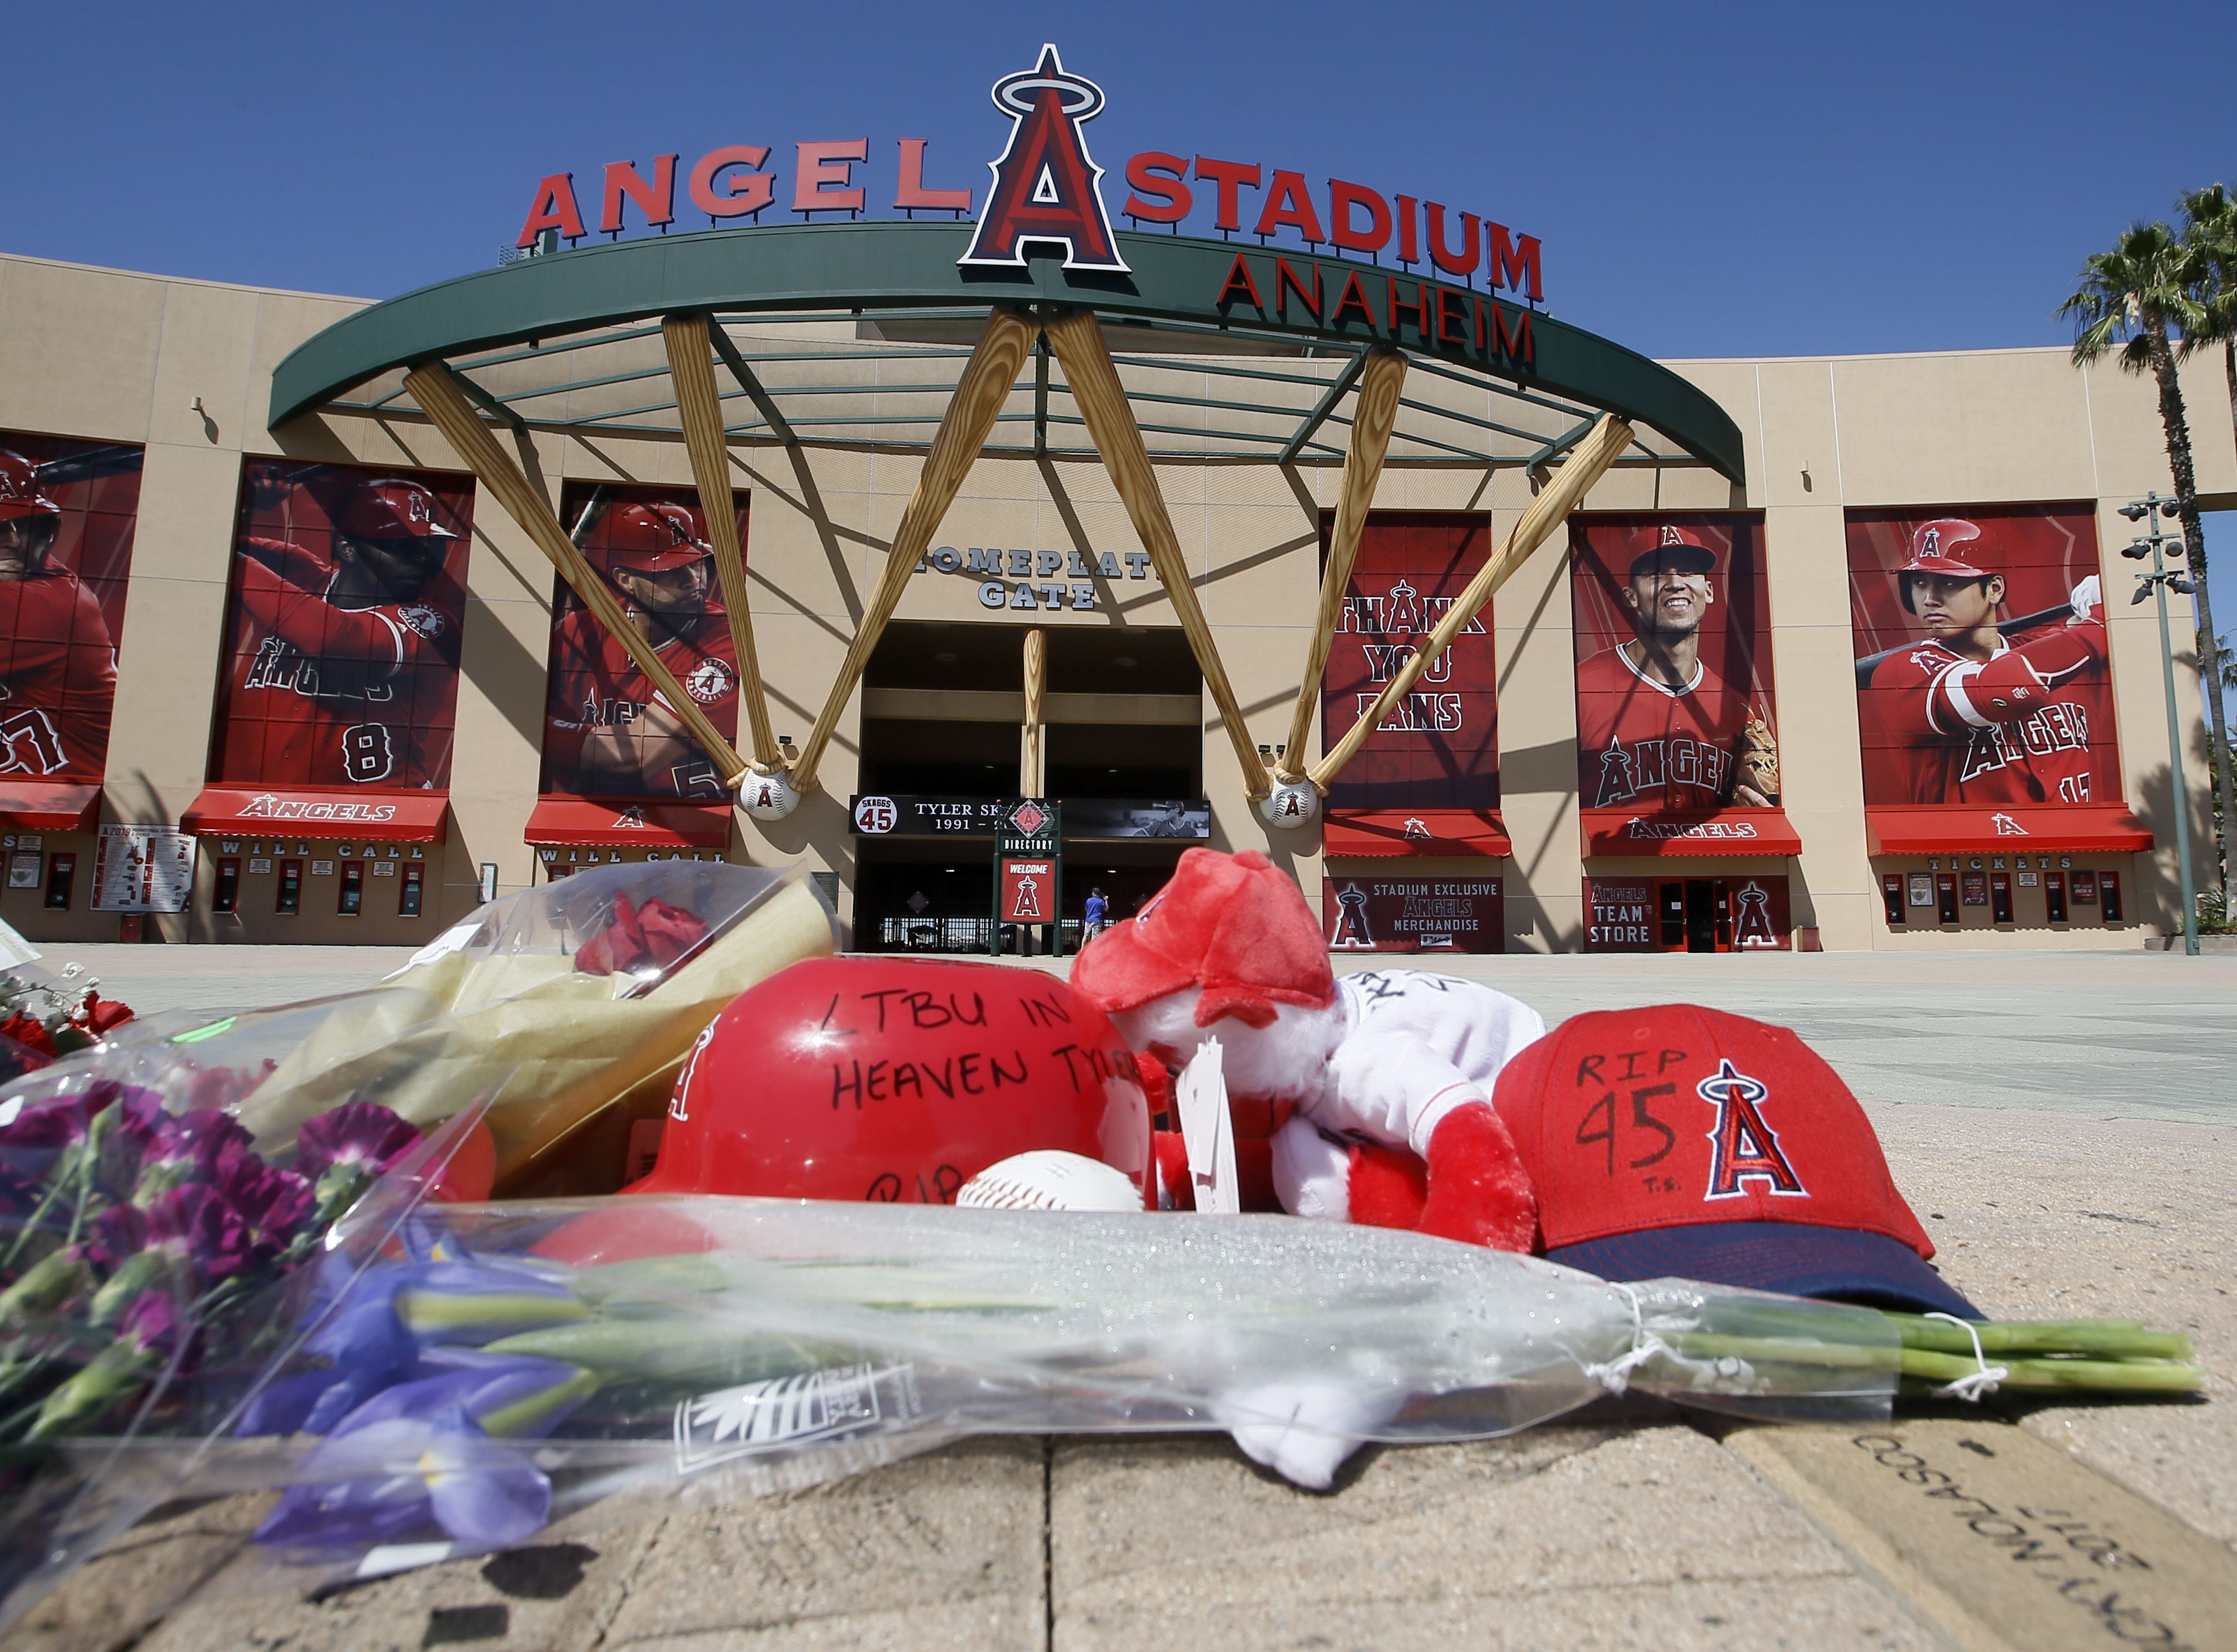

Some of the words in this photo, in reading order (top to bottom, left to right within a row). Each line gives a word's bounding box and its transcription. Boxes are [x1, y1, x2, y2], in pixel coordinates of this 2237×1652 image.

[516, 136, 973, 250] ANGEL
[1122, 151, 1544, 302] STADIUM
[1217, 251, 1533, 363] ANAHEIM
[913, 546, 1162, 580] OMEPLAT
[978, 581, 1095, 610] GATE
[341, 722, 393, 782] 8
[235, 794, 396, 821] ANGELS
[862, 798, 891, 808] SKAGGS
[915, 804, 973, 816] TYLER
[859, 808, 892, 830] 45
[935, 819, 970, 829] 1991
[1627, 817, 1758, 839] ANGELS
[110, 827, 132, 836] 2019
[221, 840, 309, 855] WILL
[337, 844, 423, 858] CALL
[1004, 839, 1053, 850] DIRECTORY
[541, 849, 621, 863] WILL
[647, 852, 725, 863] CALL
[1928, 857, 2071, 870] TICKETS
[1009, 863, 1048, 874] WELCOME
[1373, 884, 1428, 895] STADIUM
[1435, 884, 1497, 895] EXCLUSIVE
[1590, 883, 1647, 903] ANGELS
[1402, 892, 1473, 917] ANGELS
[1594, 906, 1642, 922] TEAM
[1394, 919, 1478, 931] MERCHANDISE
[1590, 926, 1649, 943] STORE
[1019, 993, 1071, 1028] IN
[1577, 1048, 1688, 1087] RIP
[832, 1050, 1029, 1109] HEAVEN
[1575, 1083, 1678, 1177] 45
[1696, 1058, 1811, 1202] A
[866, 1164, 963, 1204] RIP
